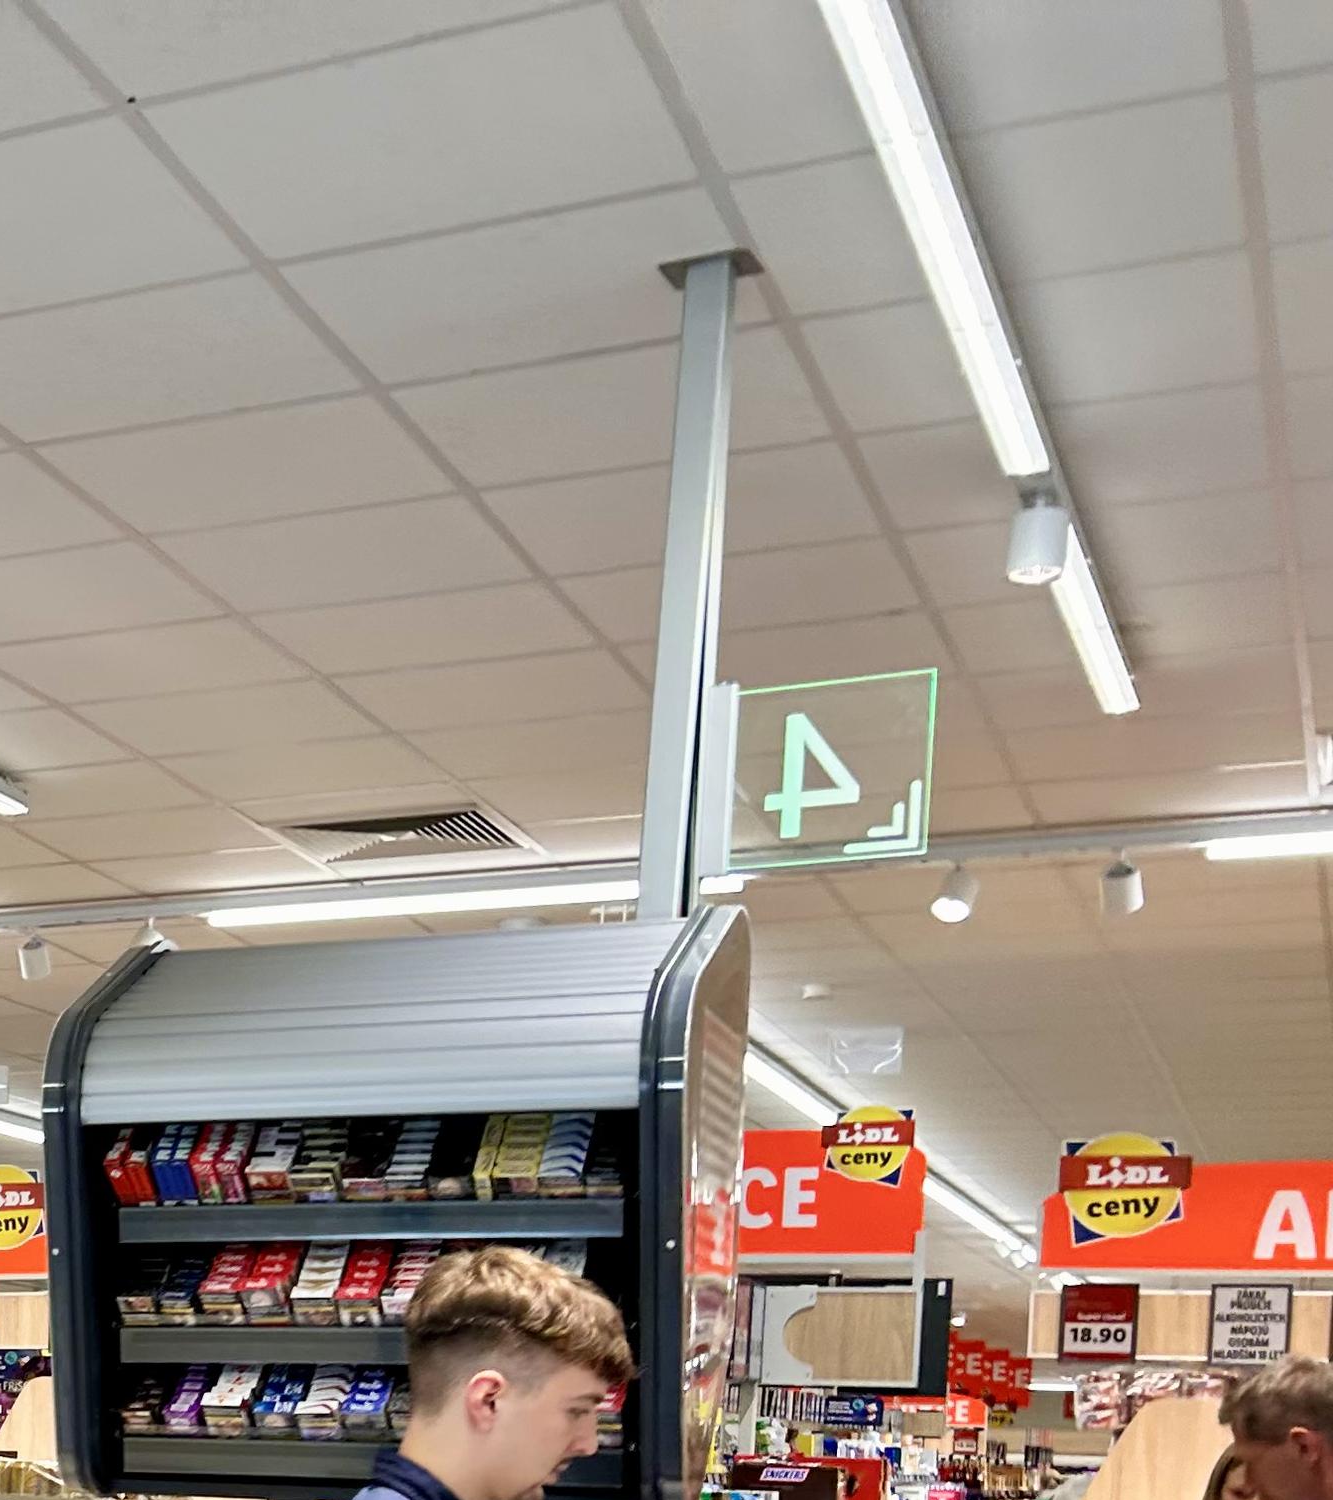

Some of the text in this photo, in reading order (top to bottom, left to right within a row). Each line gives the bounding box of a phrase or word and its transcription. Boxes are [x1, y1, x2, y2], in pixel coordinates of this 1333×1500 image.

[841, 1151, 892, 1168] ceny
[1087, 1196, 1160, 1218] ceny
[1253, 1190, 1333, 1260] A
[1070, 1327, 1126, 1343] 18.90
[764, 1470, 805, 1479] SNICKERS
